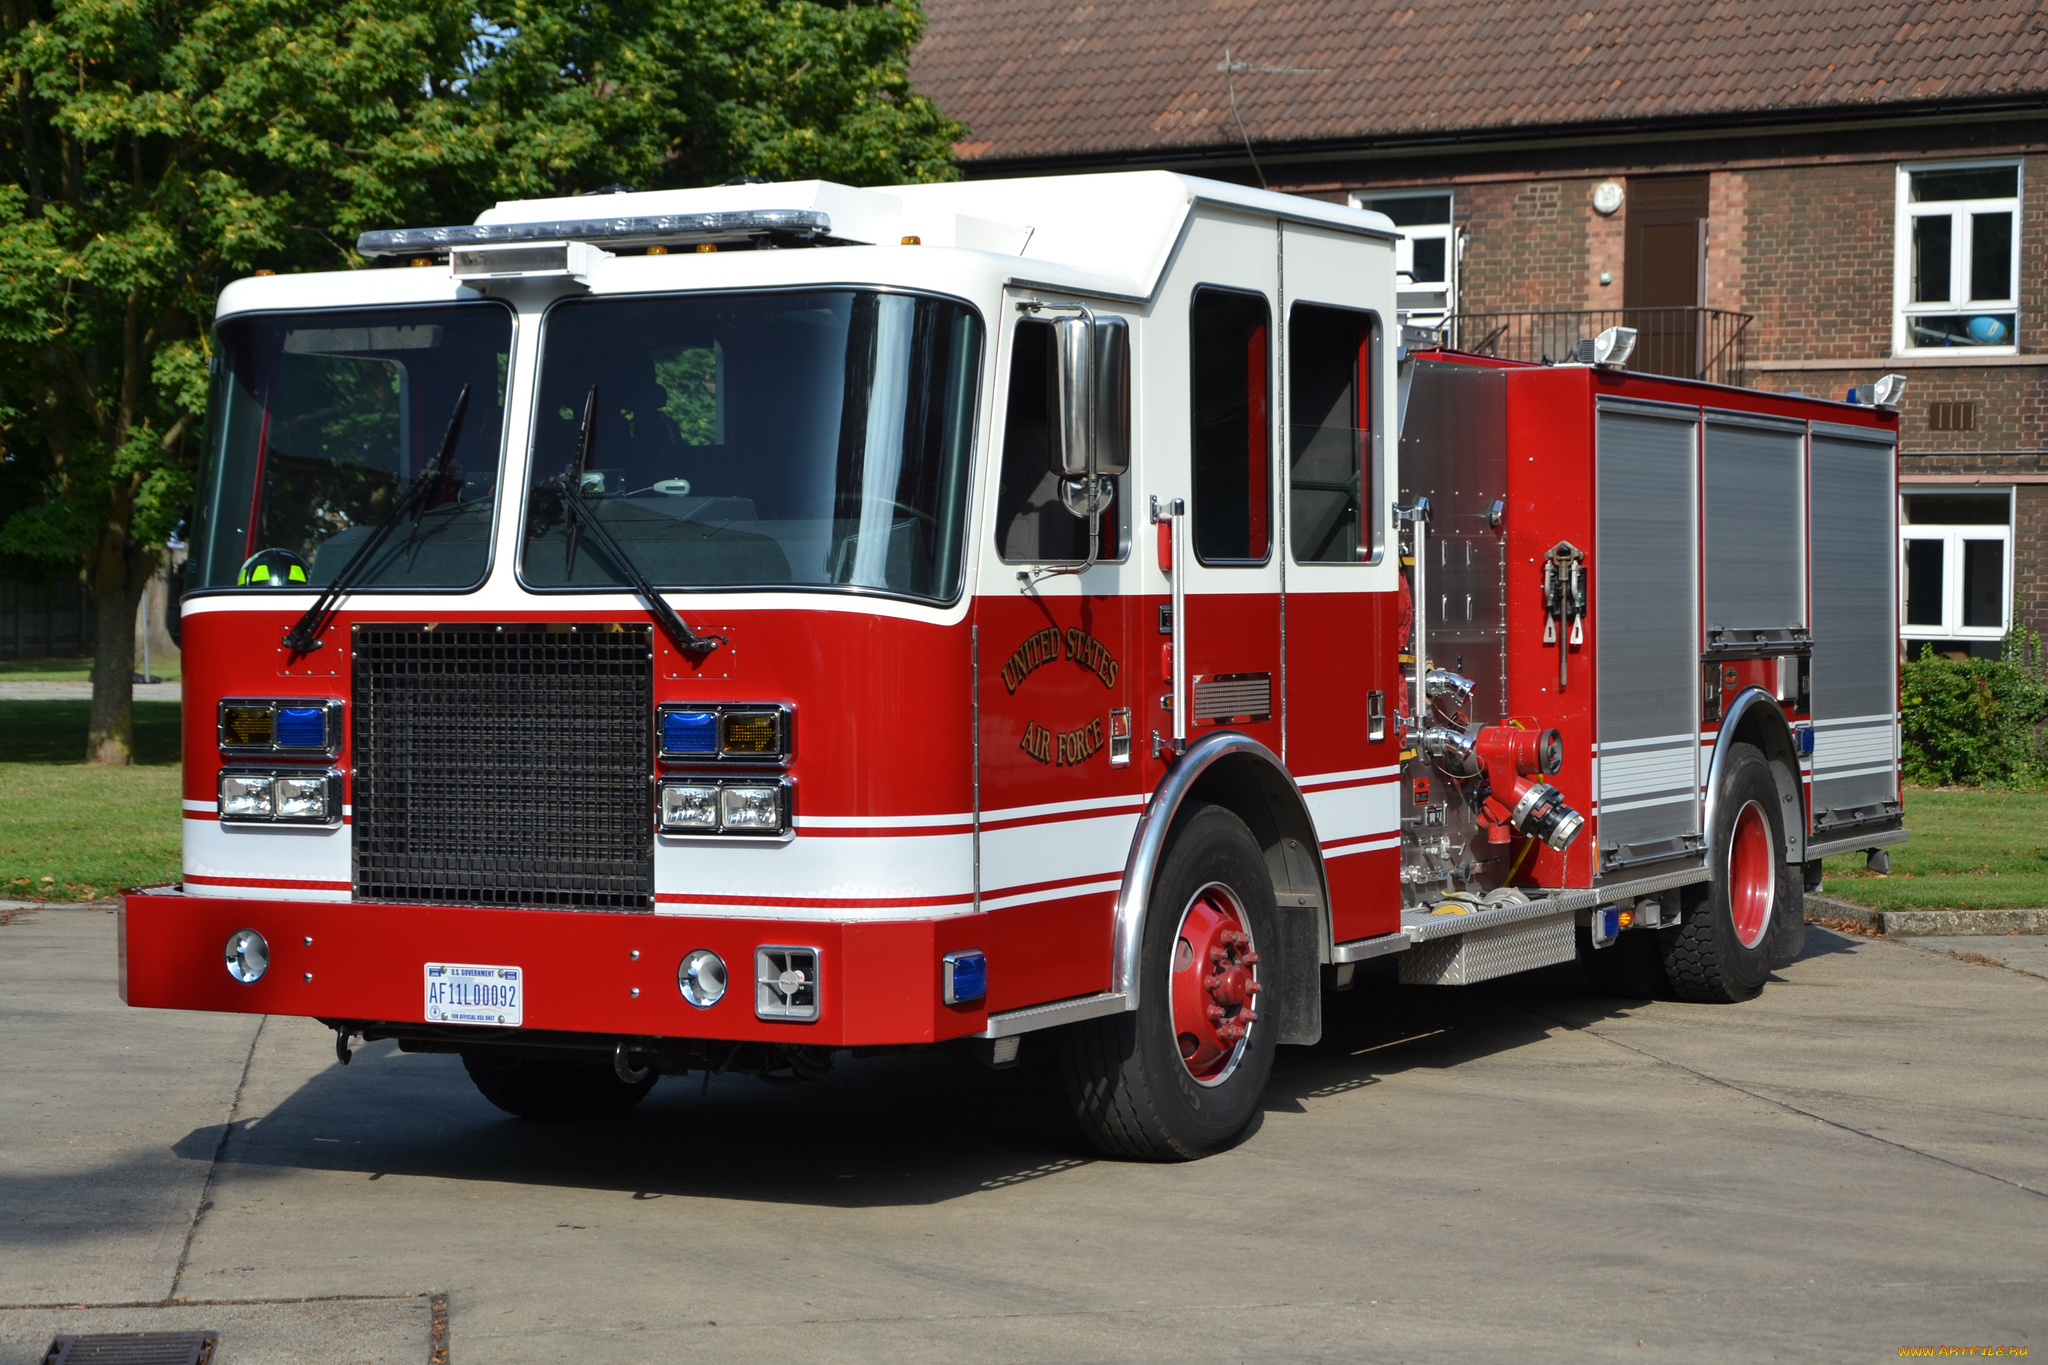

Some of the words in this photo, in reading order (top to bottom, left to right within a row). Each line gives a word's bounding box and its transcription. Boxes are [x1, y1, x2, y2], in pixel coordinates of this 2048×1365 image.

[1001, 626, 1061, 695] UNITED
[1065, 626, 1119, 690] STATES
[1019, 720, 1052, 765] AIR
[1056, 715, 1104, 767] FORCE
[461, 969, 494, 977] GOVERNMENT
[429, 982, 516, 1007] AF11L00092
